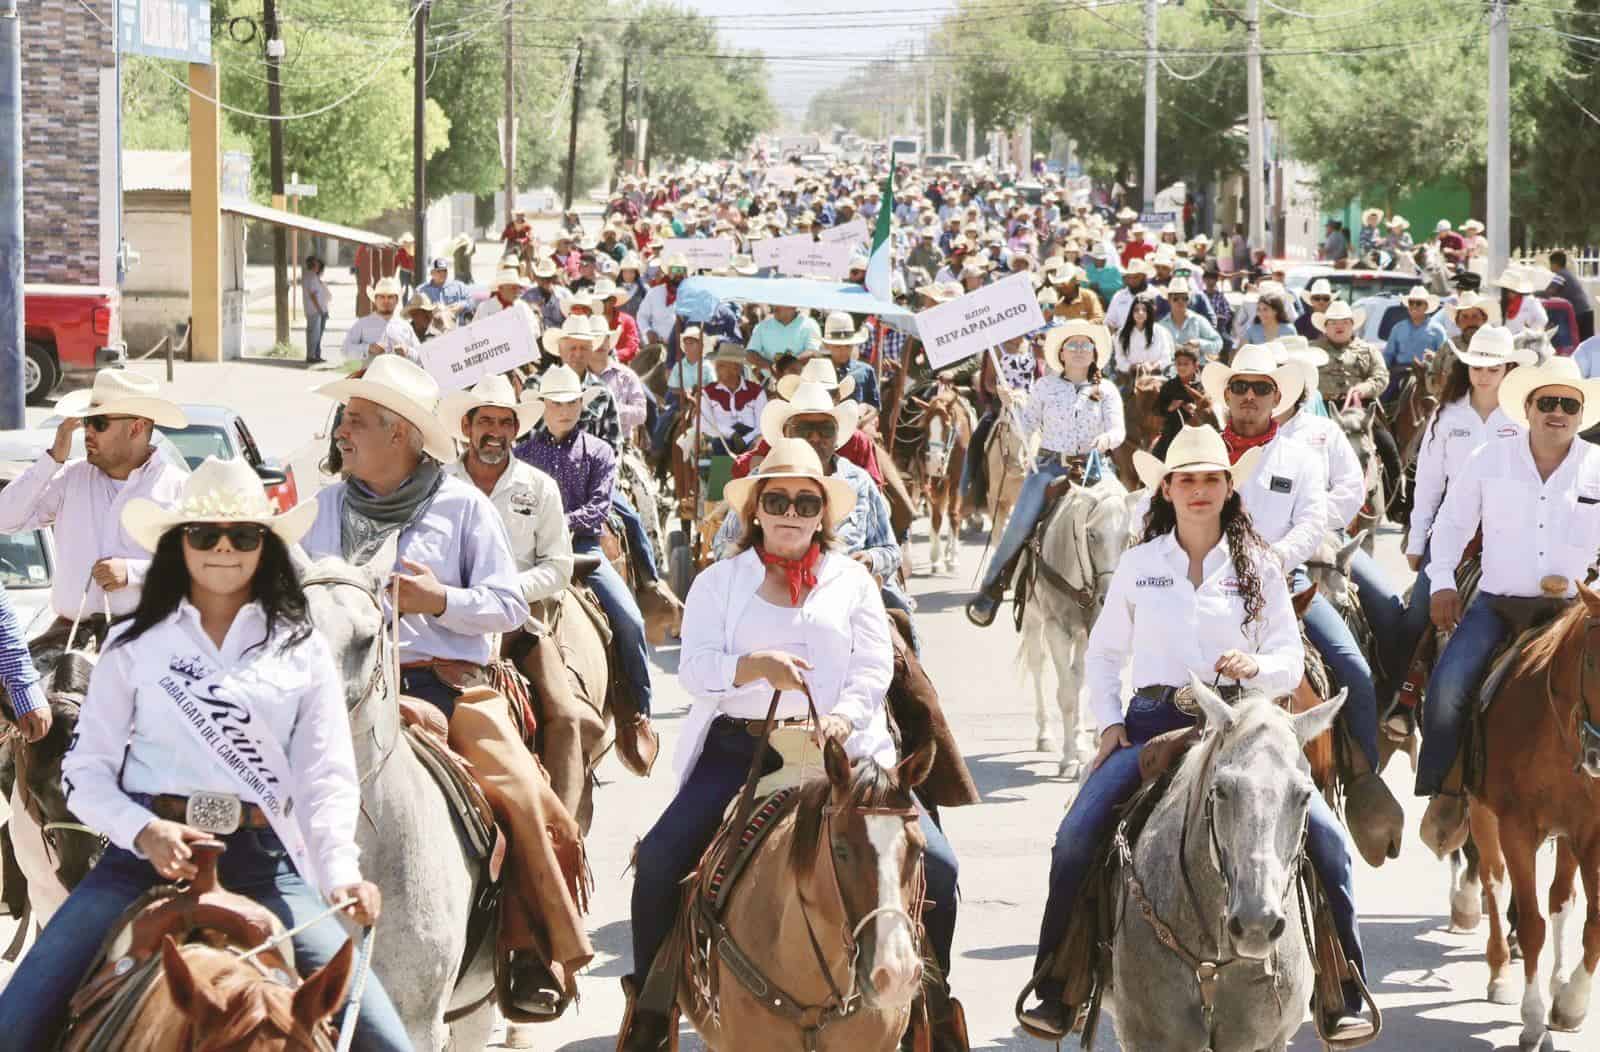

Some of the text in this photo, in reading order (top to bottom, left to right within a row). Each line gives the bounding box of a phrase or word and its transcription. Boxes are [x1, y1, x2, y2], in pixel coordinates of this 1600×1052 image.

[935, 303, 1028, 347] RIVAPALACIO
[964, 305, 991, 321] EJIDO
[451, 341, 511, 374] EL MEZQUITE
[157, 675, 207, 729] CABALGATA
[200, 726, 221, 749] DEL
[216, 743, 266, 795] CAMPESINO
[184, 680, 280, 785] Reina
